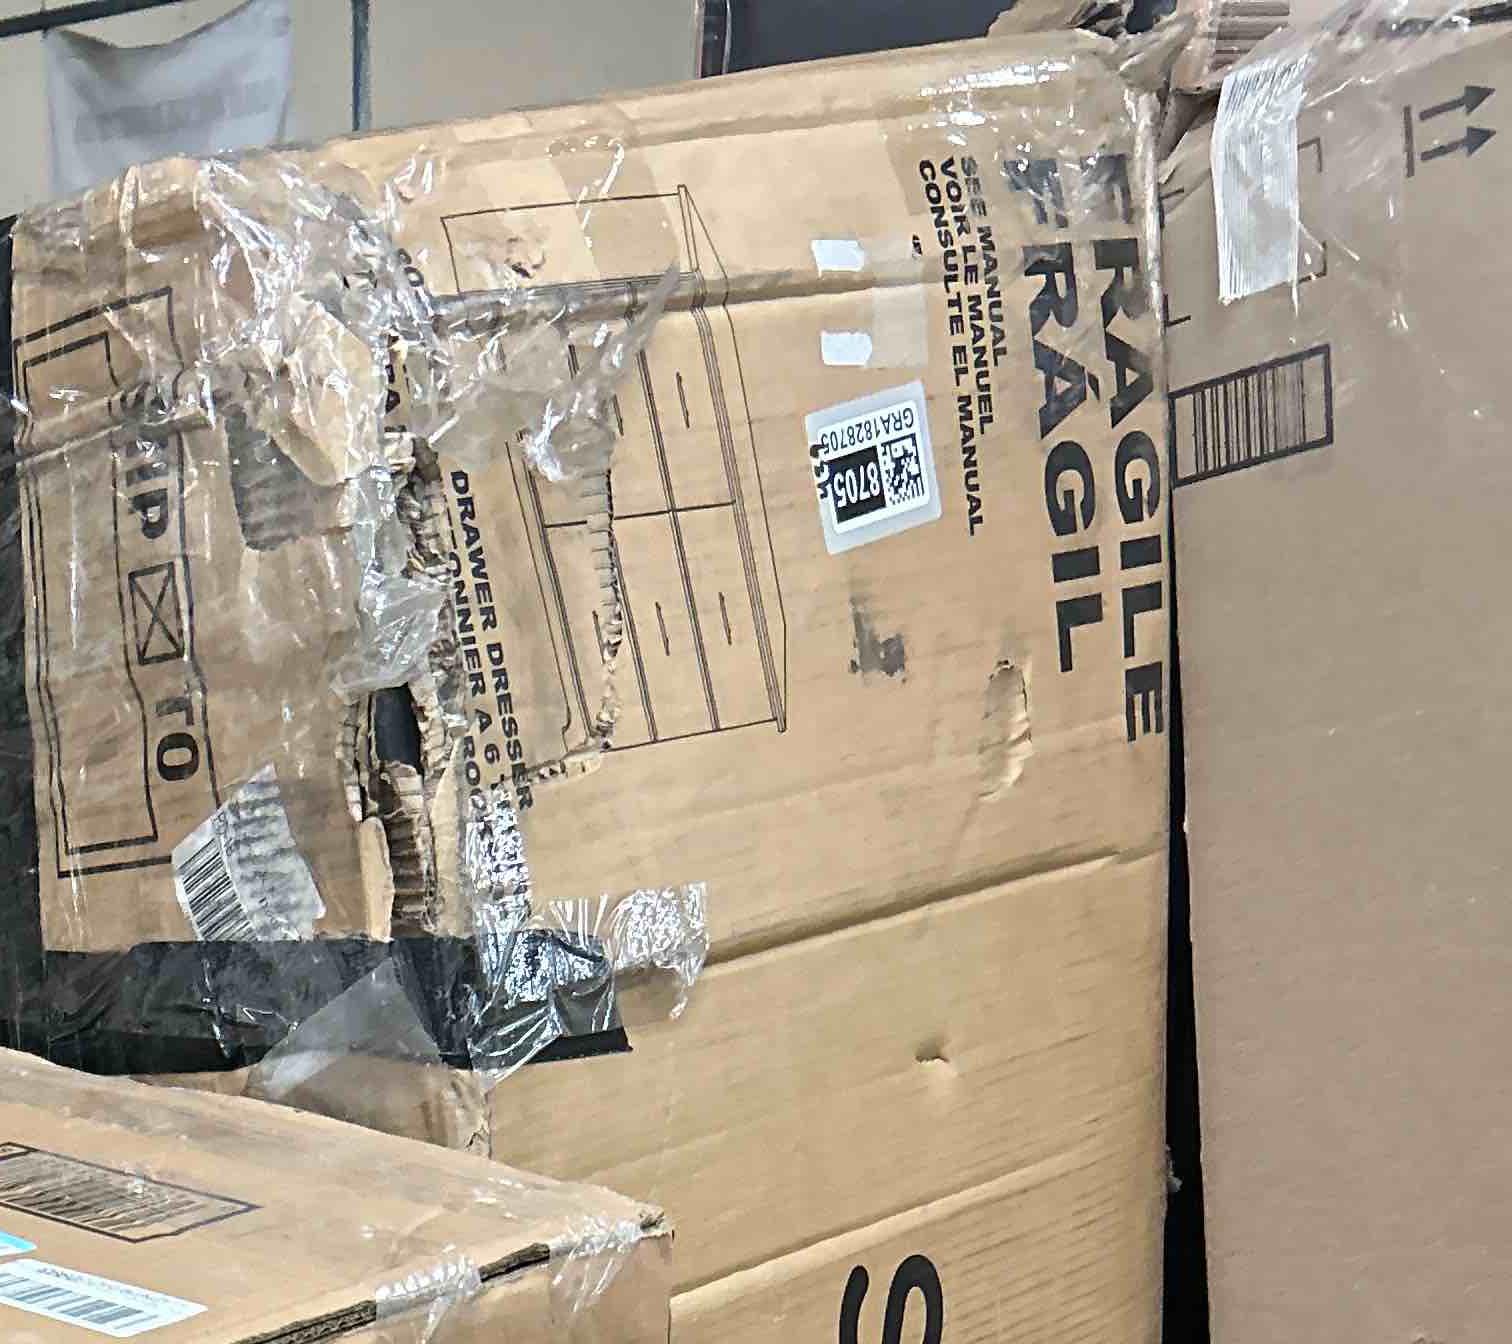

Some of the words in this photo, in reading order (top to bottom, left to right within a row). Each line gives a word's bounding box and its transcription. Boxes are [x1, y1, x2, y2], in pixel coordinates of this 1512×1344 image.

[919, 158, 965, 337] CONSULTE
[940, 156, 971, 238] VOIR
[960, 156, 988, 218] SEE
[977, 225, 1008, 367] MANUAL
[961, 245, 979, 287] LE
[821, 407, 915, 455] GRA1828705
[952, 344, 972, 387] EL
[967, 294, 996, 435] MANUEL
[1000, 159, 1104, 672] FRÁGIL
[833, 461, 881, 509] 8705
[956, 395, 984, 537] MANUAL
[1080, 153, 1165, 742] FRAGILE
[451, 469, 498, 632] DRAWER
[486, 641, 534, 812] DRESSER
[155, 694, 200, 781] TO
